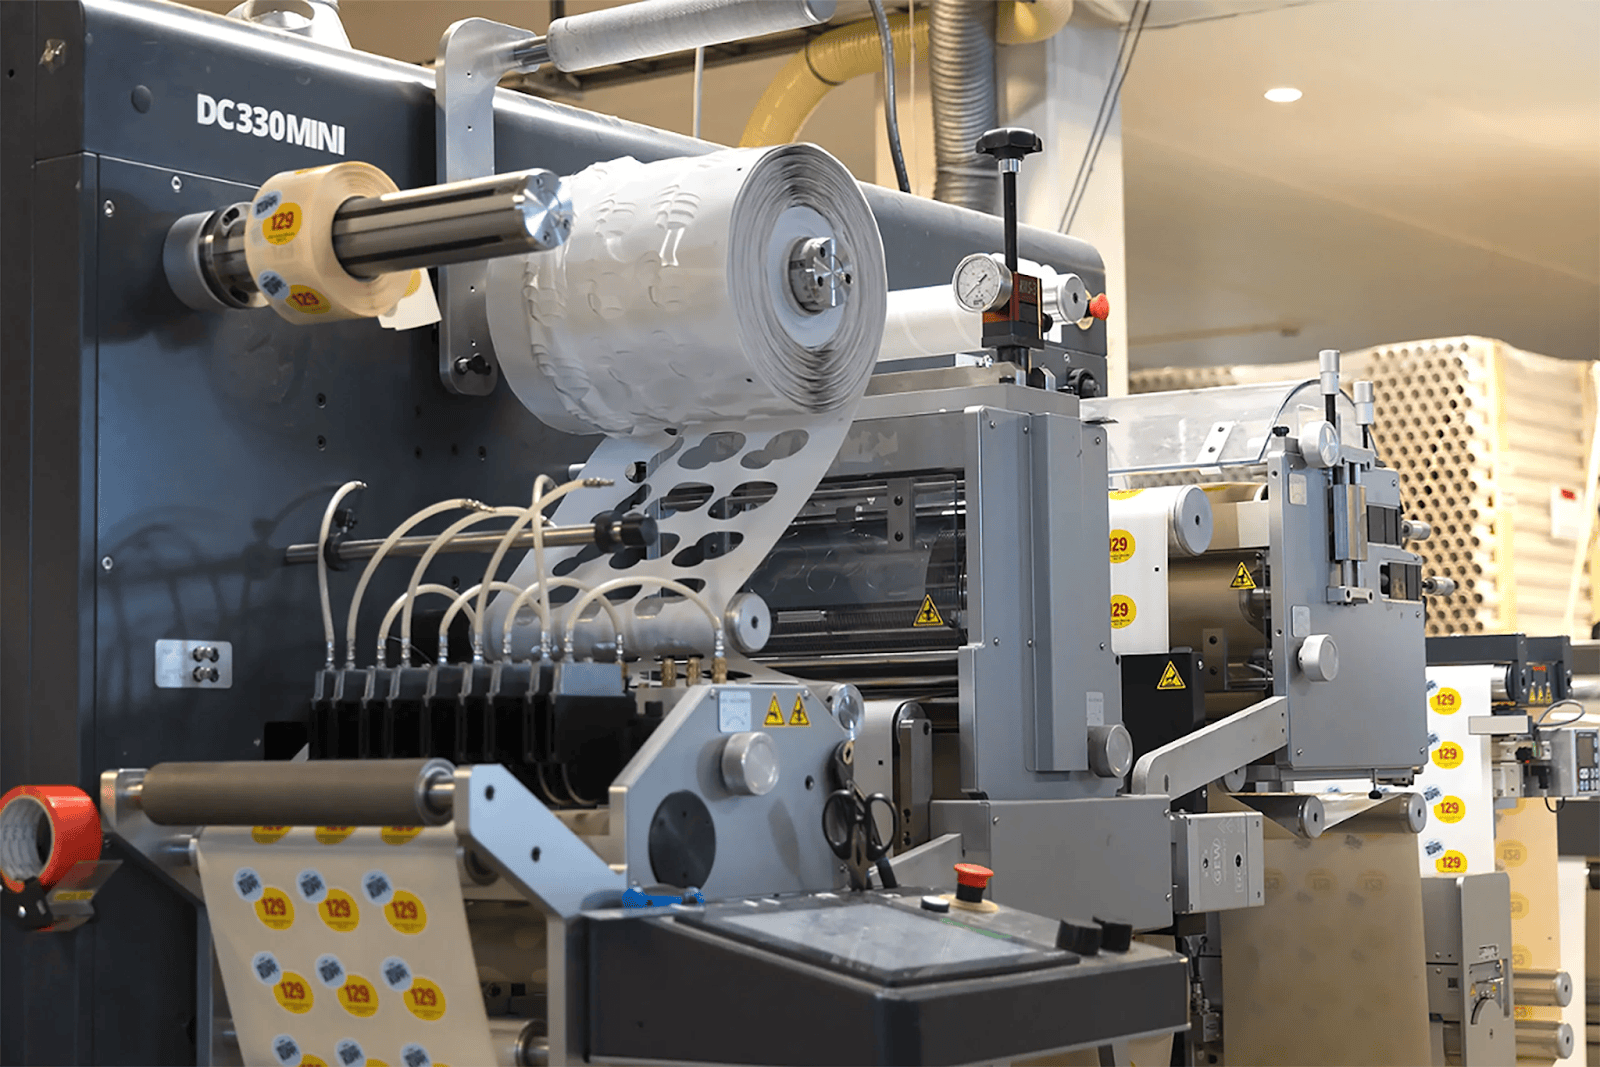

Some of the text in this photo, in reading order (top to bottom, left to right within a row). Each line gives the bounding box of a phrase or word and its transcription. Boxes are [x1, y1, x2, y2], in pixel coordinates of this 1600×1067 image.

[197, 93, 345, 155] DC330MINI
[271, 211, 294, 231] 129
[292, 291, 319, 306] 129
[1436, 694, 1455, 705] 129
[1439, 748, 1457, 759] 129
[1440, 802, 1459, 814] 129
[1213, 841, 1221, 882] GEW
[1442, 856, 1461, 868] 129
[262, 897, 286, 916] 129
[326, 899, 351, 918] 129
[392, 900, 418, 920] 129
[281, 981, 305, 1000] 129
[345, 984, 370, 1003] 129
[411, 987, 437, 1006] 129
